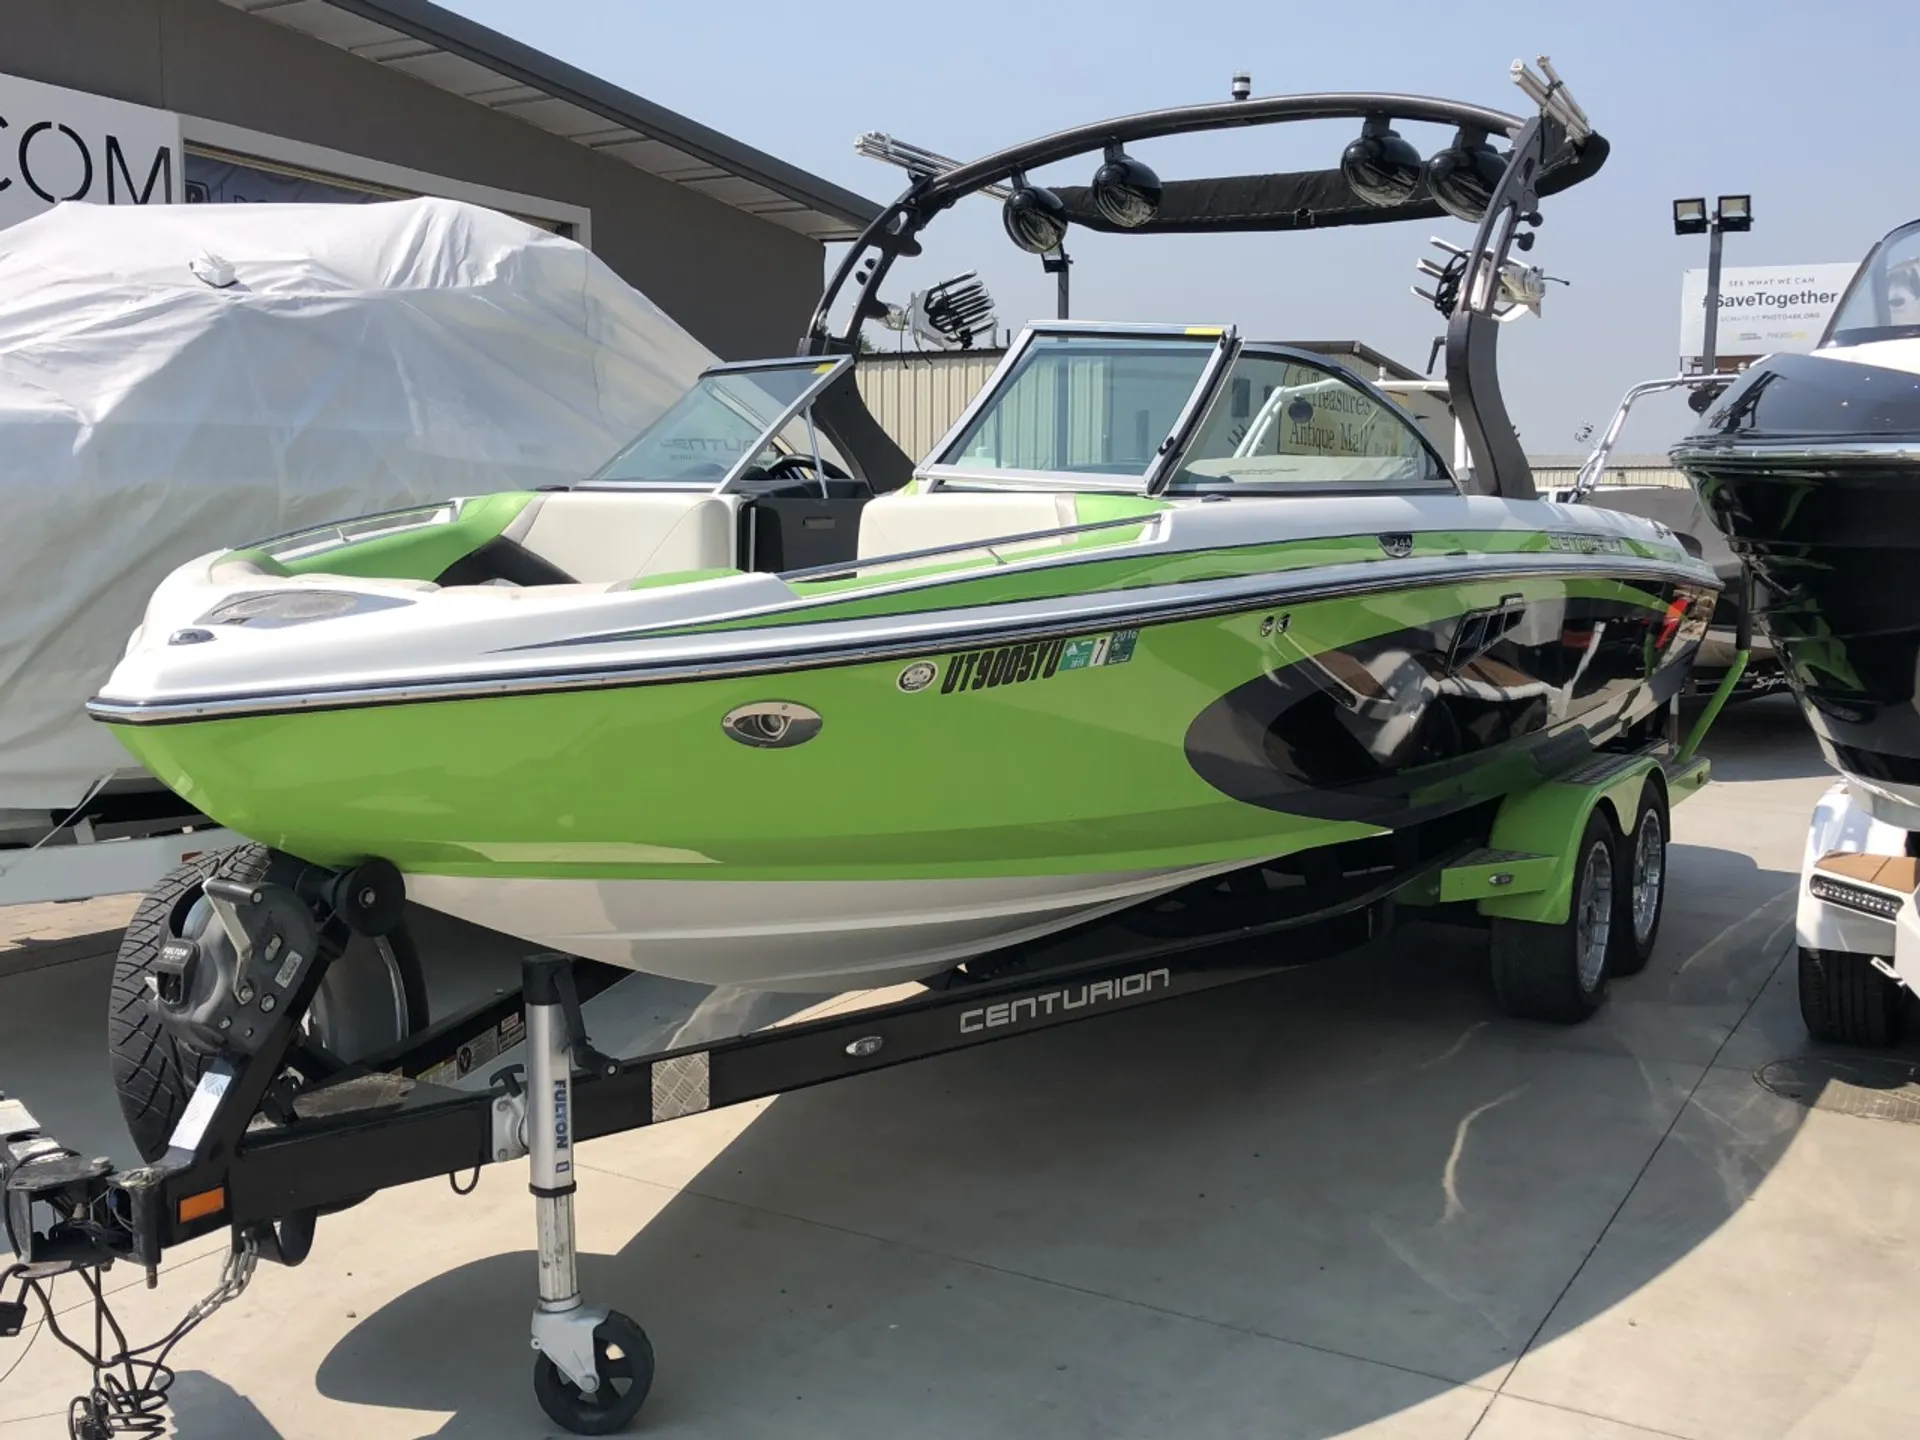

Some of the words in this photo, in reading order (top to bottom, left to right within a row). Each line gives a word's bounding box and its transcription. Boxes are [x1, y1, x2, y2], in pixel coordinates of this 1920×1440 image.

[0, 115, 172, 204] OM
[1747, 279, 1774, 287] WHAT
[1794, 276, 1815, 285] CAN
[1289, 419, 1336, 455] Antique
[941, 639, 1067, 694] UT9005YU
[960, 968, 1170, 1033] CENTURION
[554, 1080, 569, 1149] FULTON
